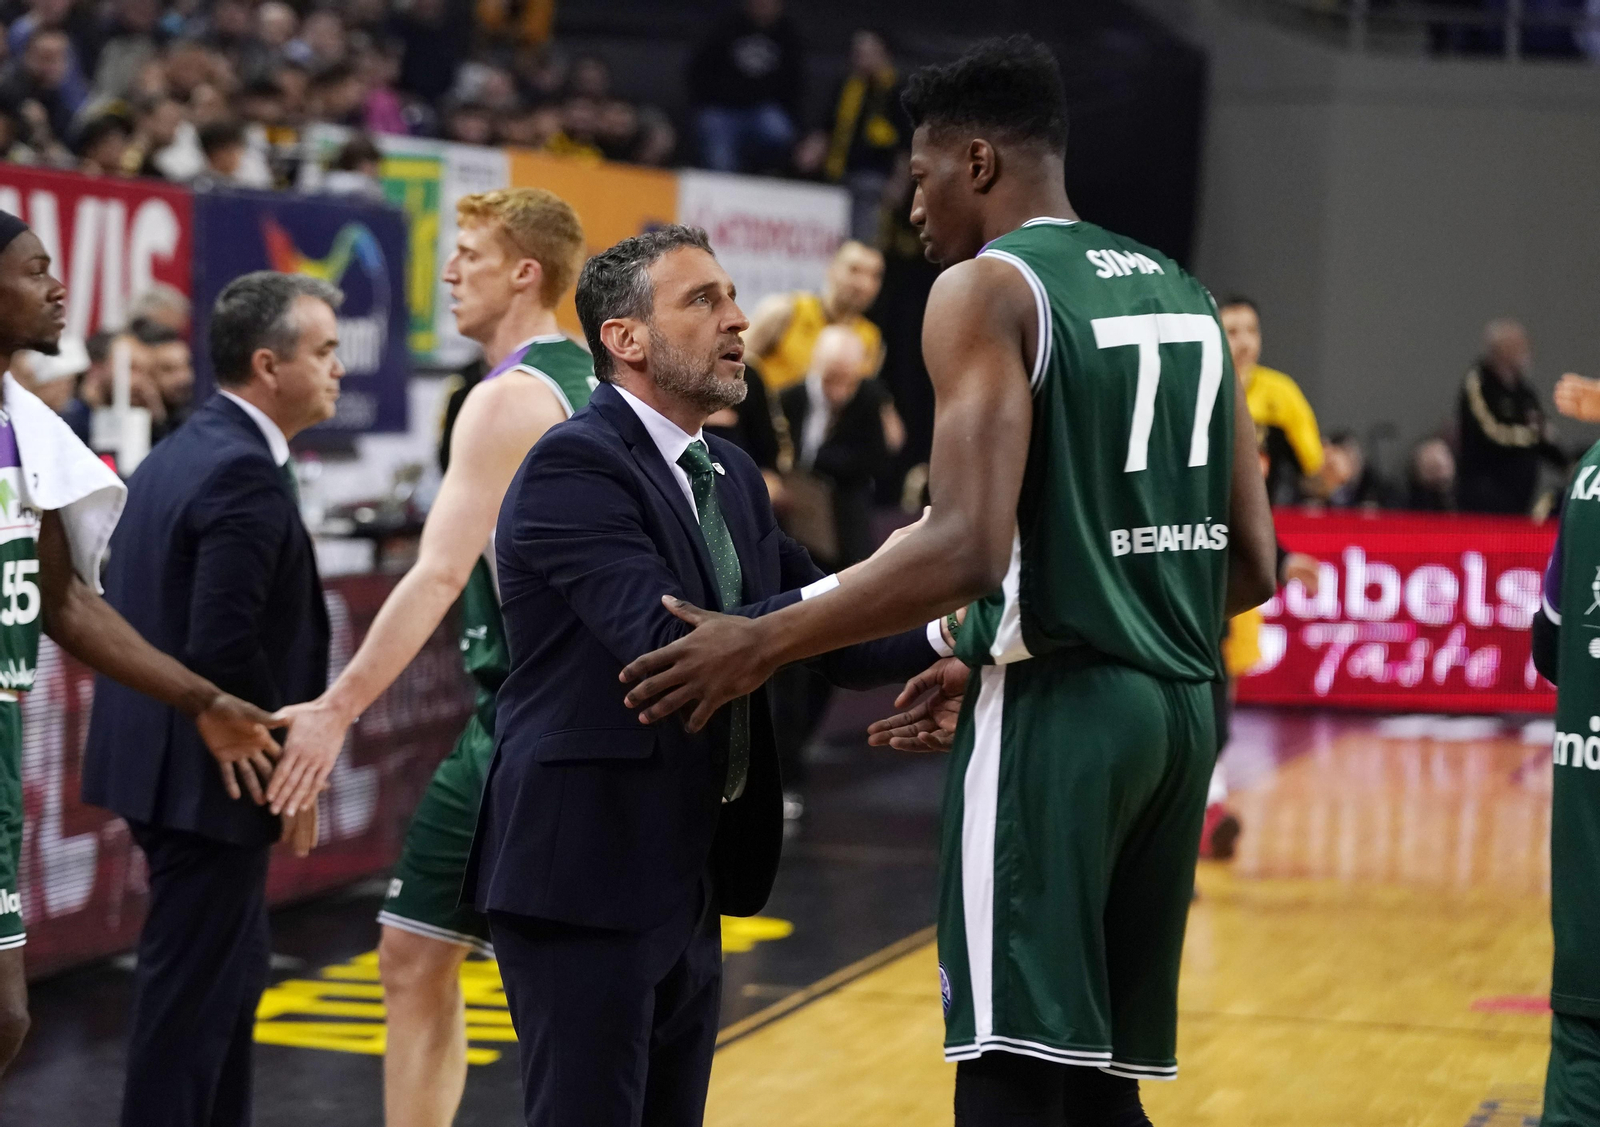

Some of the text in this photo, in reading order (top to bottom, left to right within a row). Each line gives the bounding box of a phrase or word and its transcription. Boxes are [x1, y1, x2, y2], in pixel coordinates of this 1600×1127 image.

[0, 186, 181, 342] VIS
[1085, 249, 1165, 279] SIMA
[1091, 313, 1223, 472] 77
[1, 558, 41, 626] 55
[1257, 545, 1541, 630] abels
